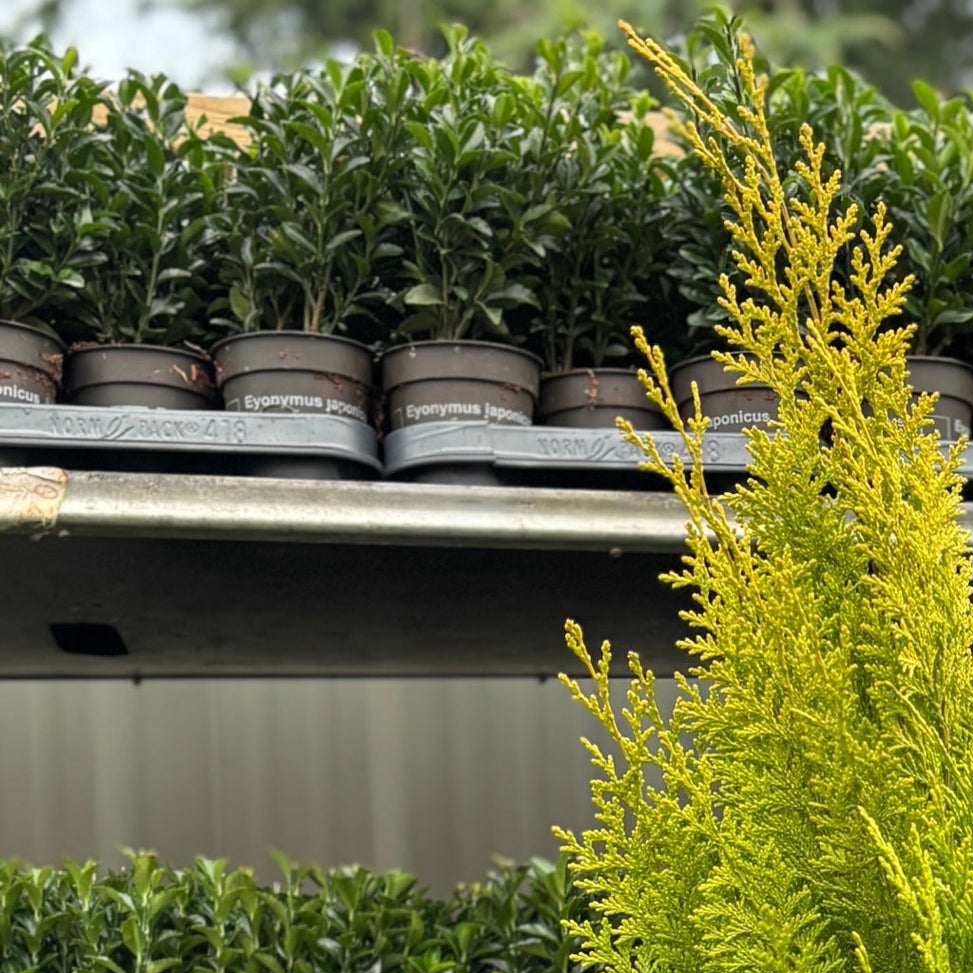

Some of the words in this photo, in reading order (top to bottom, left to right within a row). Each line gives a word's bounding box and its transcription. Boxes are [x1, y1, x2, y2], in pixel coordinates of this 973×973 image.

[244, 394, 322, 411] Eyonymus
[406, 402, 481, 420] Eyonymus
[706, 410, 770, 430] aponicus
